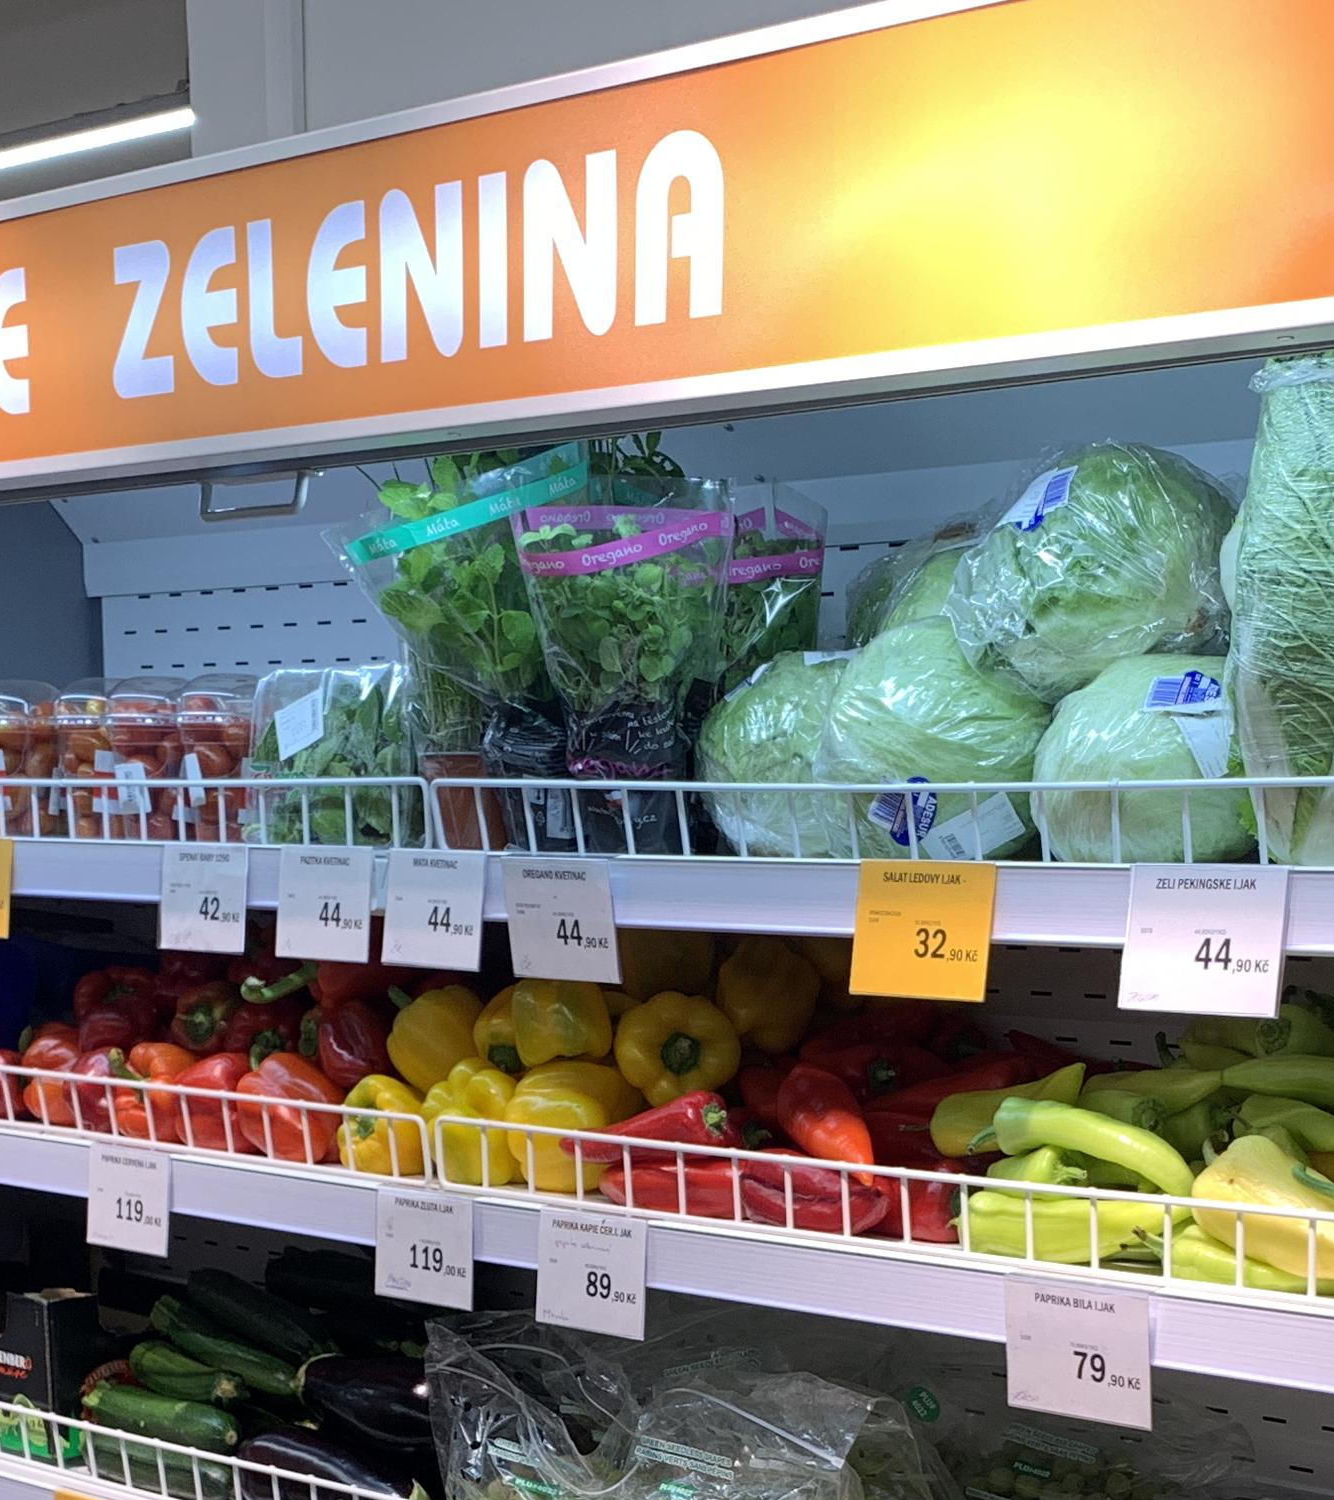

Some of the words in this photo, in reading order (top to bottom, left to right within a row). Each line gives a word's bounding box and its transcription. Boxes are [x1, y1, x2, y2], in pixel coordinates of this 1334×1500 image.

[111, 128, 725, 400] ZELENINA
[548, 476, 577, 496] Máta
[426, 516, 460, 537] Máta
[658, 521, 708, 547] Oregano
[581, 543, 644, 568] Oregano
[522, 869, 553, 880] OREGANO
[554, 870, 587, 882] KVETINAC
[882, 871, 907, 883] SALAT
[908, 872, 938, 885] LEDOVY
[1155, 877, 1175, 890] ZELI
[1176, 877, 1231, 891] PEKINGSKE
[427, 906, 462, 935] 44,90
[556, 918, 595, 948] 44,90
[913, 927, 962, 964] 32,90
[964, 947, 978, 962] Kč
[1193, 938, 1250, 976] 44,90
[1252, 957, 1268, 974] Kč
[586, 1271, 624, 1303] 89,90
[626, 1292, 636, 1304] Kč
[1033, 1291, 1072, 1308] PAPRIKA
[1073, 1298, 1093, 1310] BILA
[1073, 1350, 1124, 1388] 79,90
[1127, 1374, 1141, 1391] Kč
